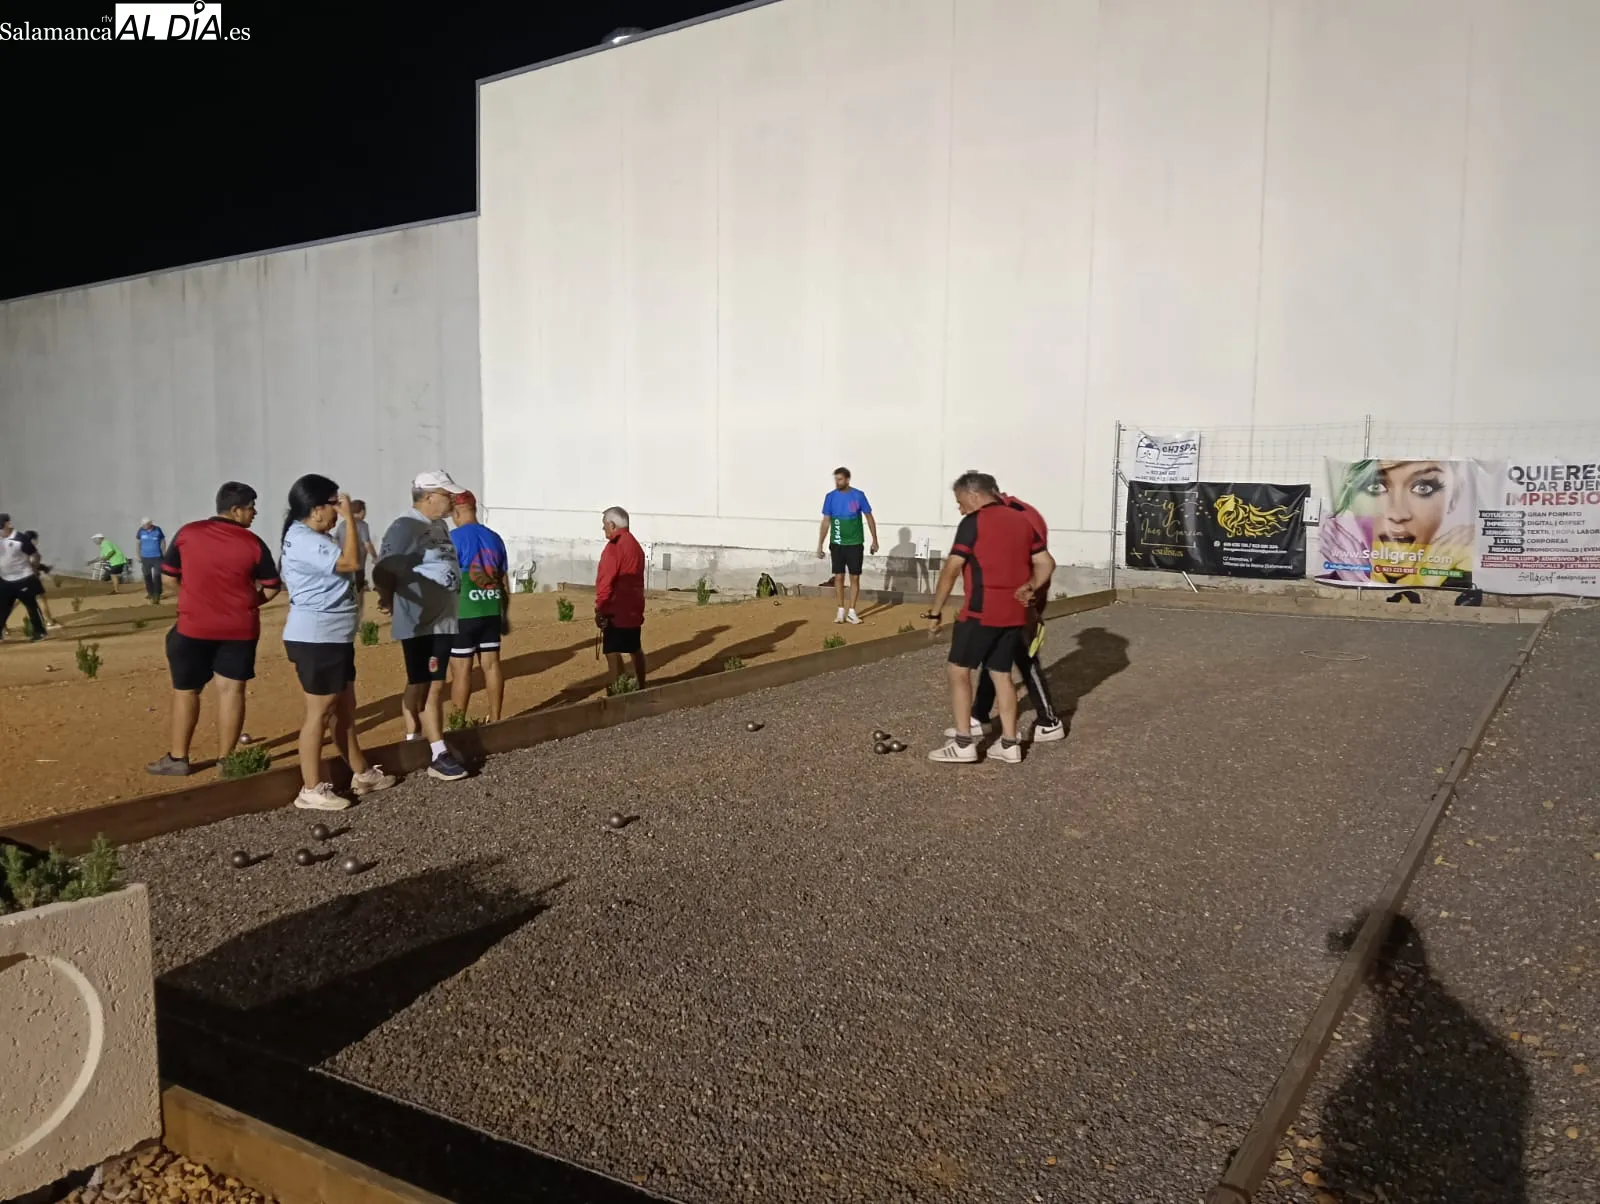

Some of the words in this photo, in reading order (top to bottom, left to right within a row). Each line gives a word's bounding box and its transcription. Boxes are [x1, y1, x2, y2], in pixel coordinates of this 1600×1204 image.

[1508, 464, 1600, 485] QUIERE
[1526, 482, 1558, 492] DAR
[1331, 546, 1453, 565] www.sellgraf.com
